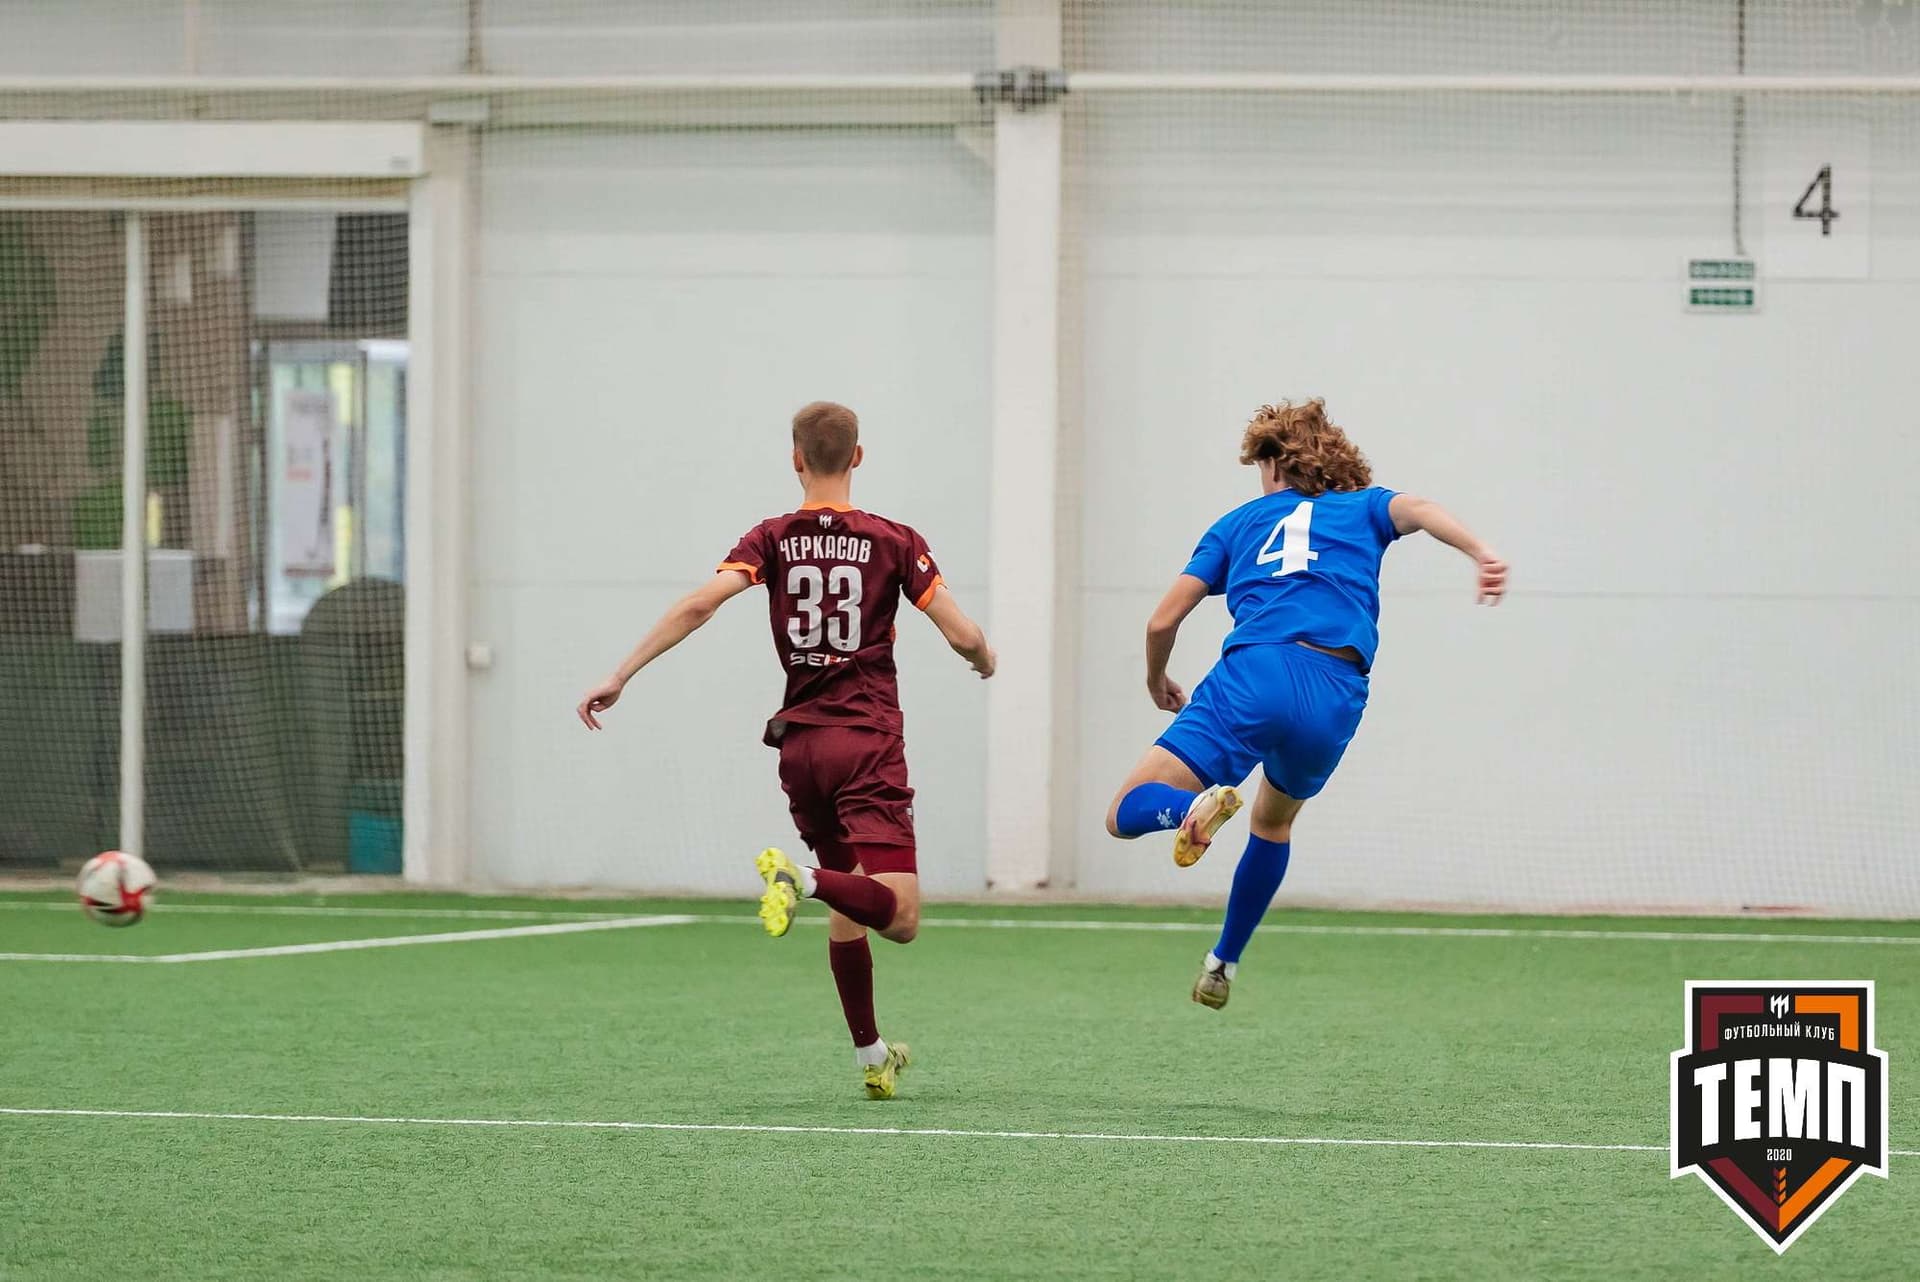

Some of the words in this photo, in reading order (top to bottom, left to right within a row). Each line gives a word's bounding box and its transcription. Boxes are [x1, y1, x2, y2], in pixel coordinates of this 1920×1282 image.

[1793, 164, 1839, 235] 4
[779, 535, 872, 563] ЧЕРКАСОВ
[1256, 501, 1319, 577] 4
[787, 565, 863, 651] 33
